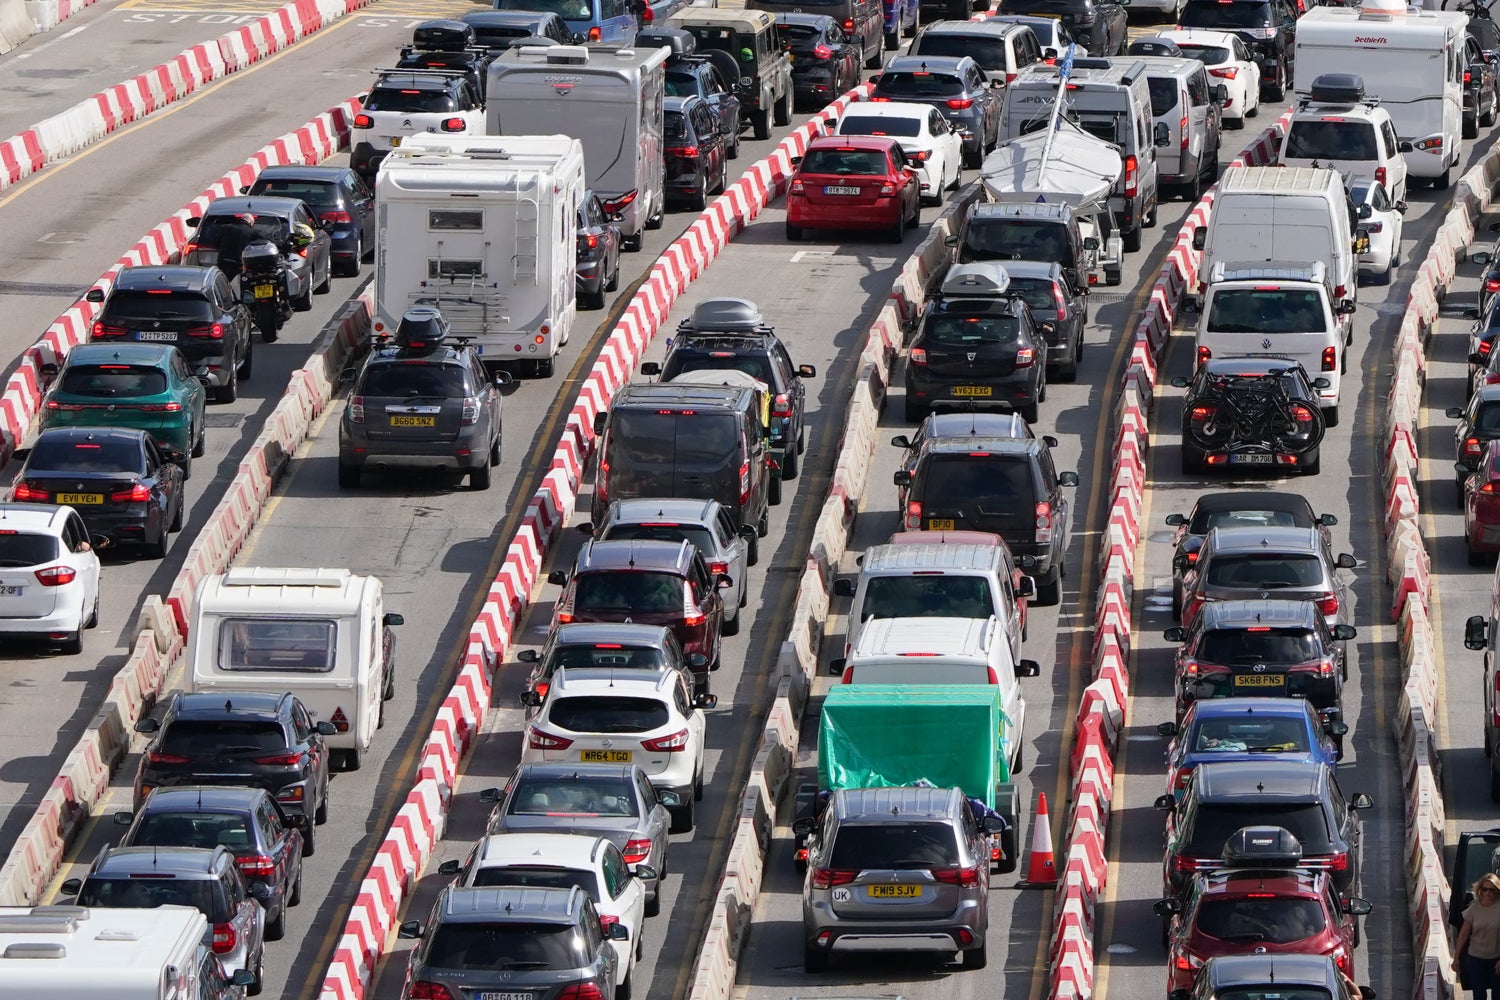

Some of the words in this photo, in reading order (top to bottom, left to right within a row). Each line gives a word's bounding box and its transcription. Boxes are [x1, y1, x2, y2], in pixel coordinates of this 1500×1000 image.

[1354, 35, 1388, 44] Dethleffs
[162, 332, 178, 341] 5287
[953, 386, 973, 395] AV63
[974, 386, 989, 395] EXG
[394, 416, 415, 426] B660
[416, 416, 432, 426] SNZ
[1260, 454, 1272, 463] 700
[81, 494, 98, 504] YEH
[1238, 675, 1262, 685] SK68
[1263, 675, 1281, 685] FNS
[585, 750, 609, 761] WR64
[611, 750, 629, 761] TGO
[832, 889, 848, 900] UK
[873, 884, 896, 895] FM19
[897, 884, 916, 895] SJV
